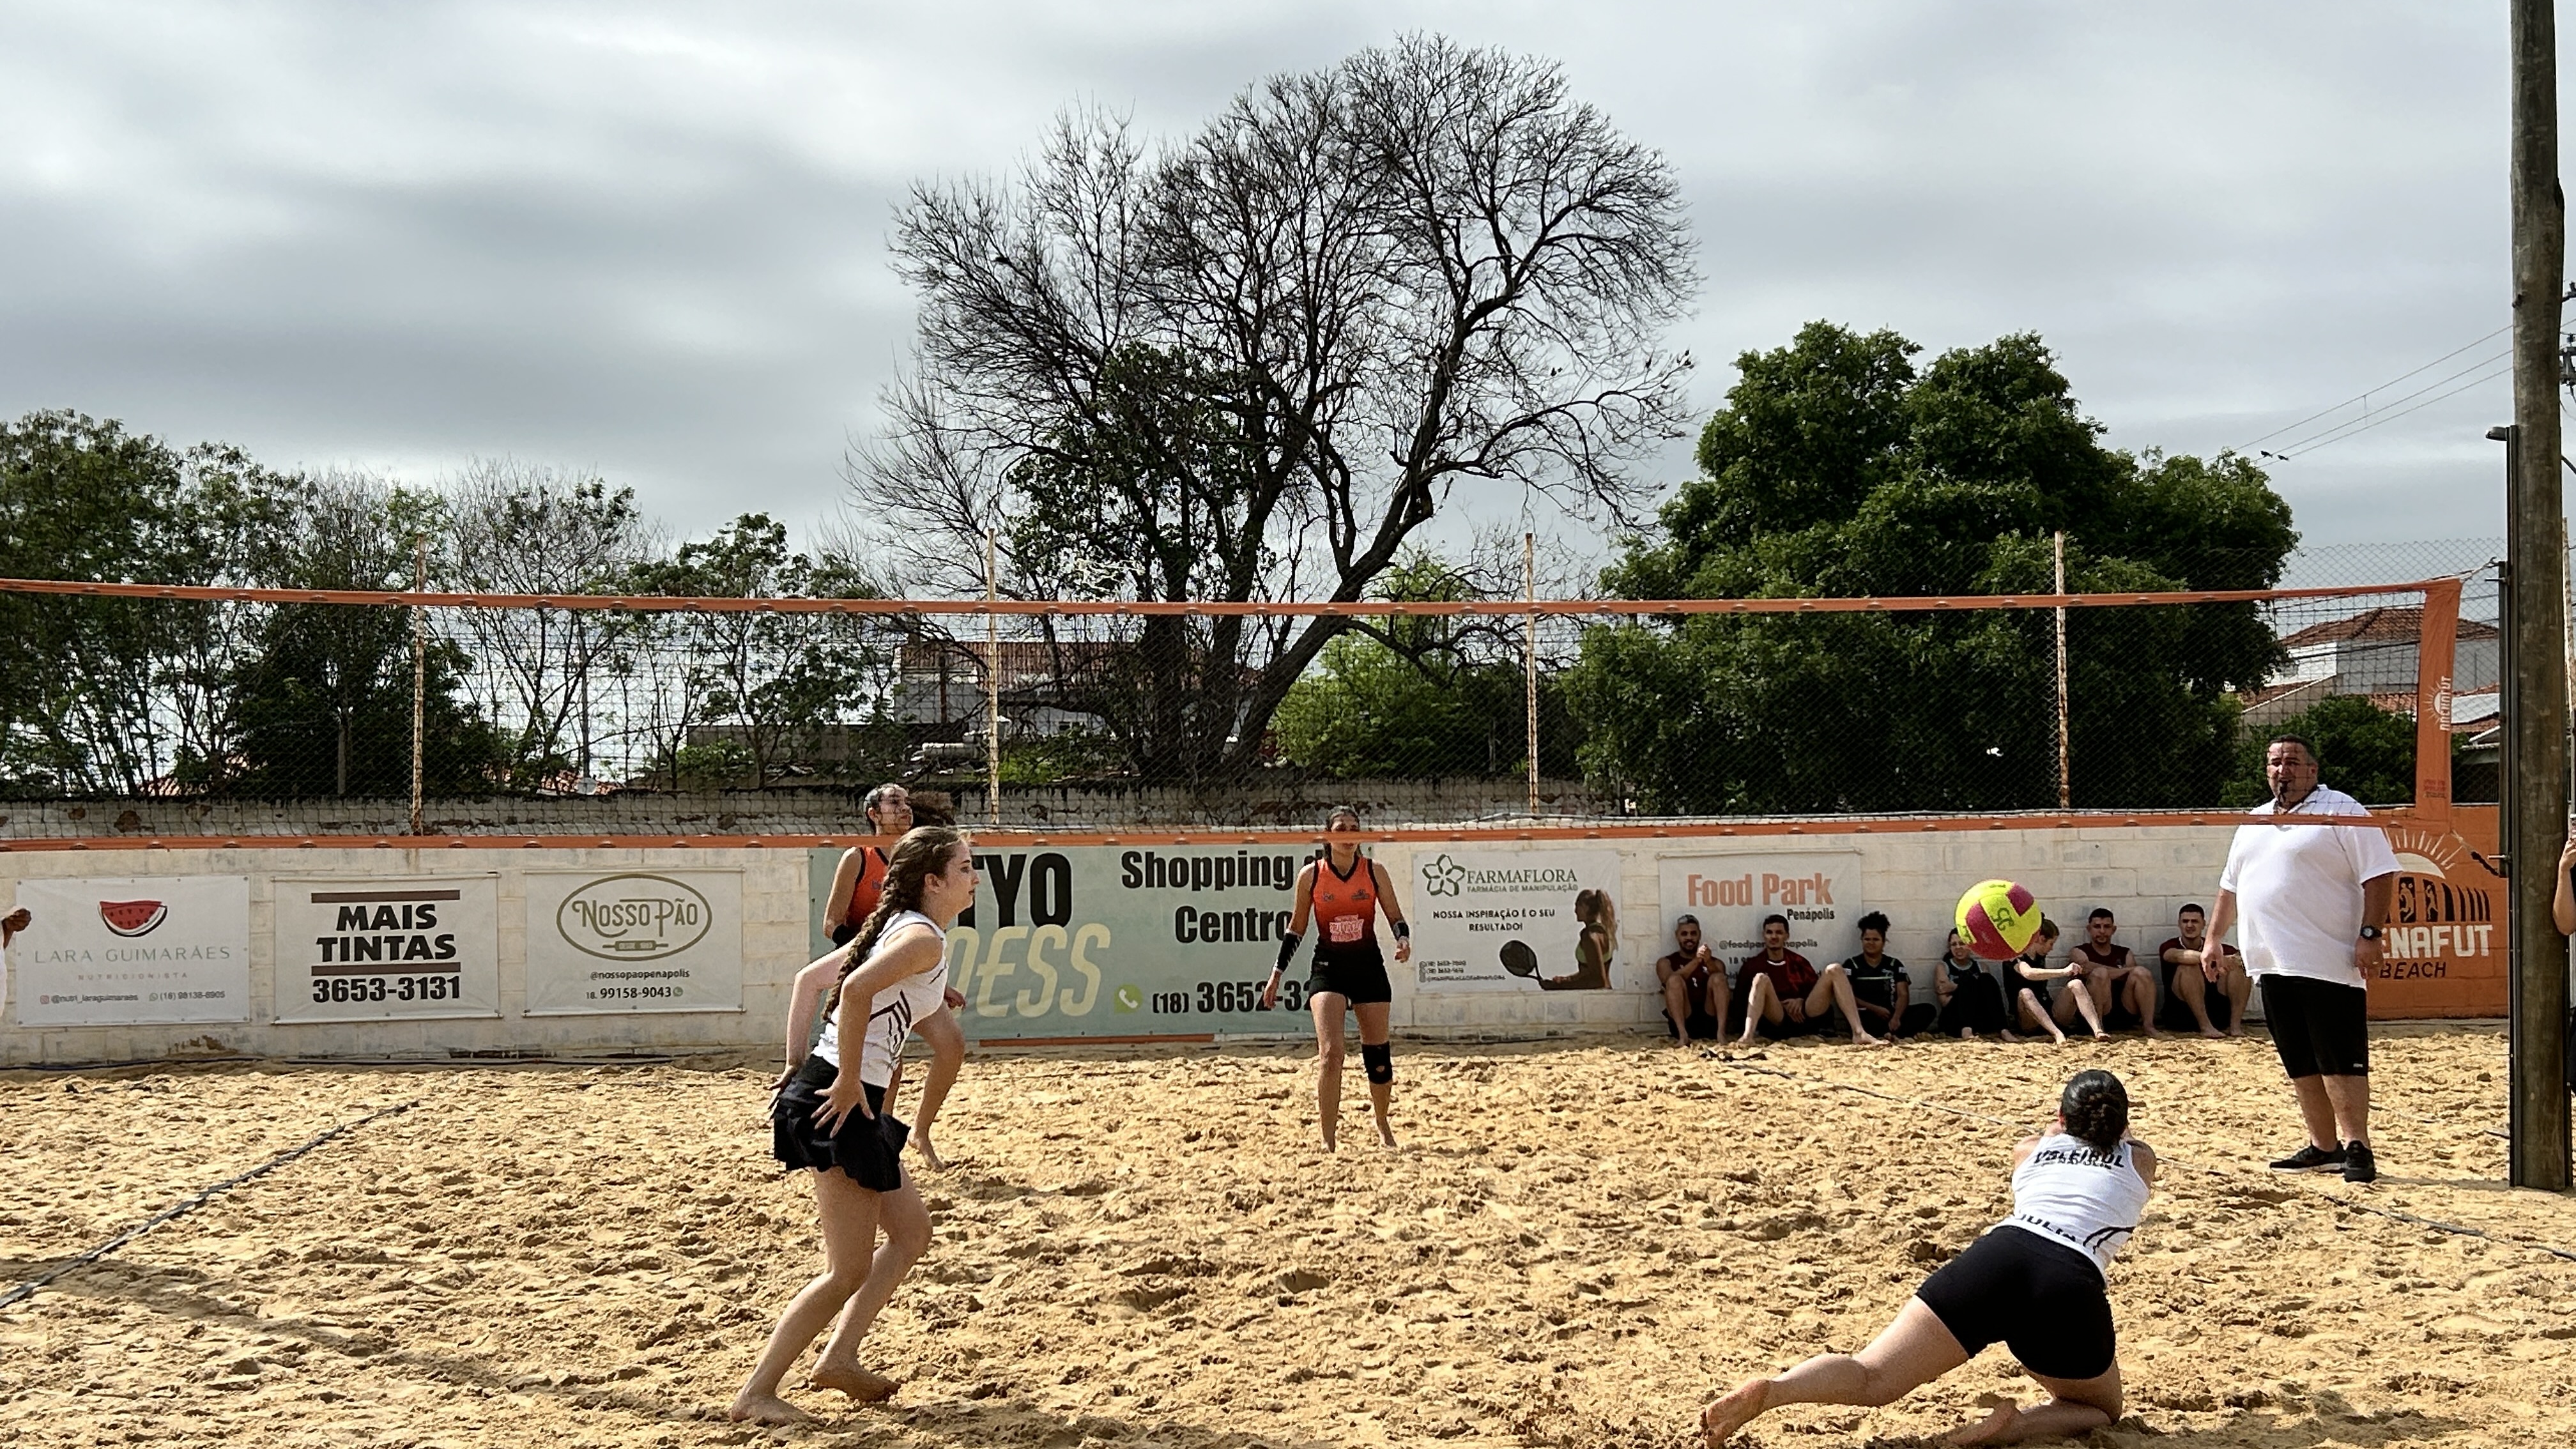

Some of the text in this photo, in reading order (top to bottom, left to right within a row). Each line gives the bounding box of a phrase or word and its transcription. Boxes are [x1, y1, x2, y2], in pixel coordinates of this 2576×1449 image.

[1121, 850, 1294, 891] Shopping
[1467, 868, 1577, 884] FARMAFLORA
[1522, 884, 1578, 893] MANIPULAÇÃO
[1687, 873, 1834, 907] Food Park
[335, 904, 437, 931] MAIS
[572, 898, 698, 938] NOSSO PÃO
[1433, 910, 1463, 919] NOSSA
[1529, 909, 1537, 917] O
[1540, 908, 1555, 917] SEU
[1786, 907, 1835, 922] Penápolis
[1175, 905, 1292, 944] Centro
[34, 949, 93, 963] LARA
[316, 934, 457, 962] TINTAS
[78, 972, 188, 981] NUTRICIONISTA
[590, 969, 690, 980] @nossopaopenapolis
[2379, 962, 2446, 979] BEACH
[312, 976, 460, 1003] 3653-3131
[600, 986, 671, 999] 99158-9043
[1152, 992, 1189, 1013] (18)
